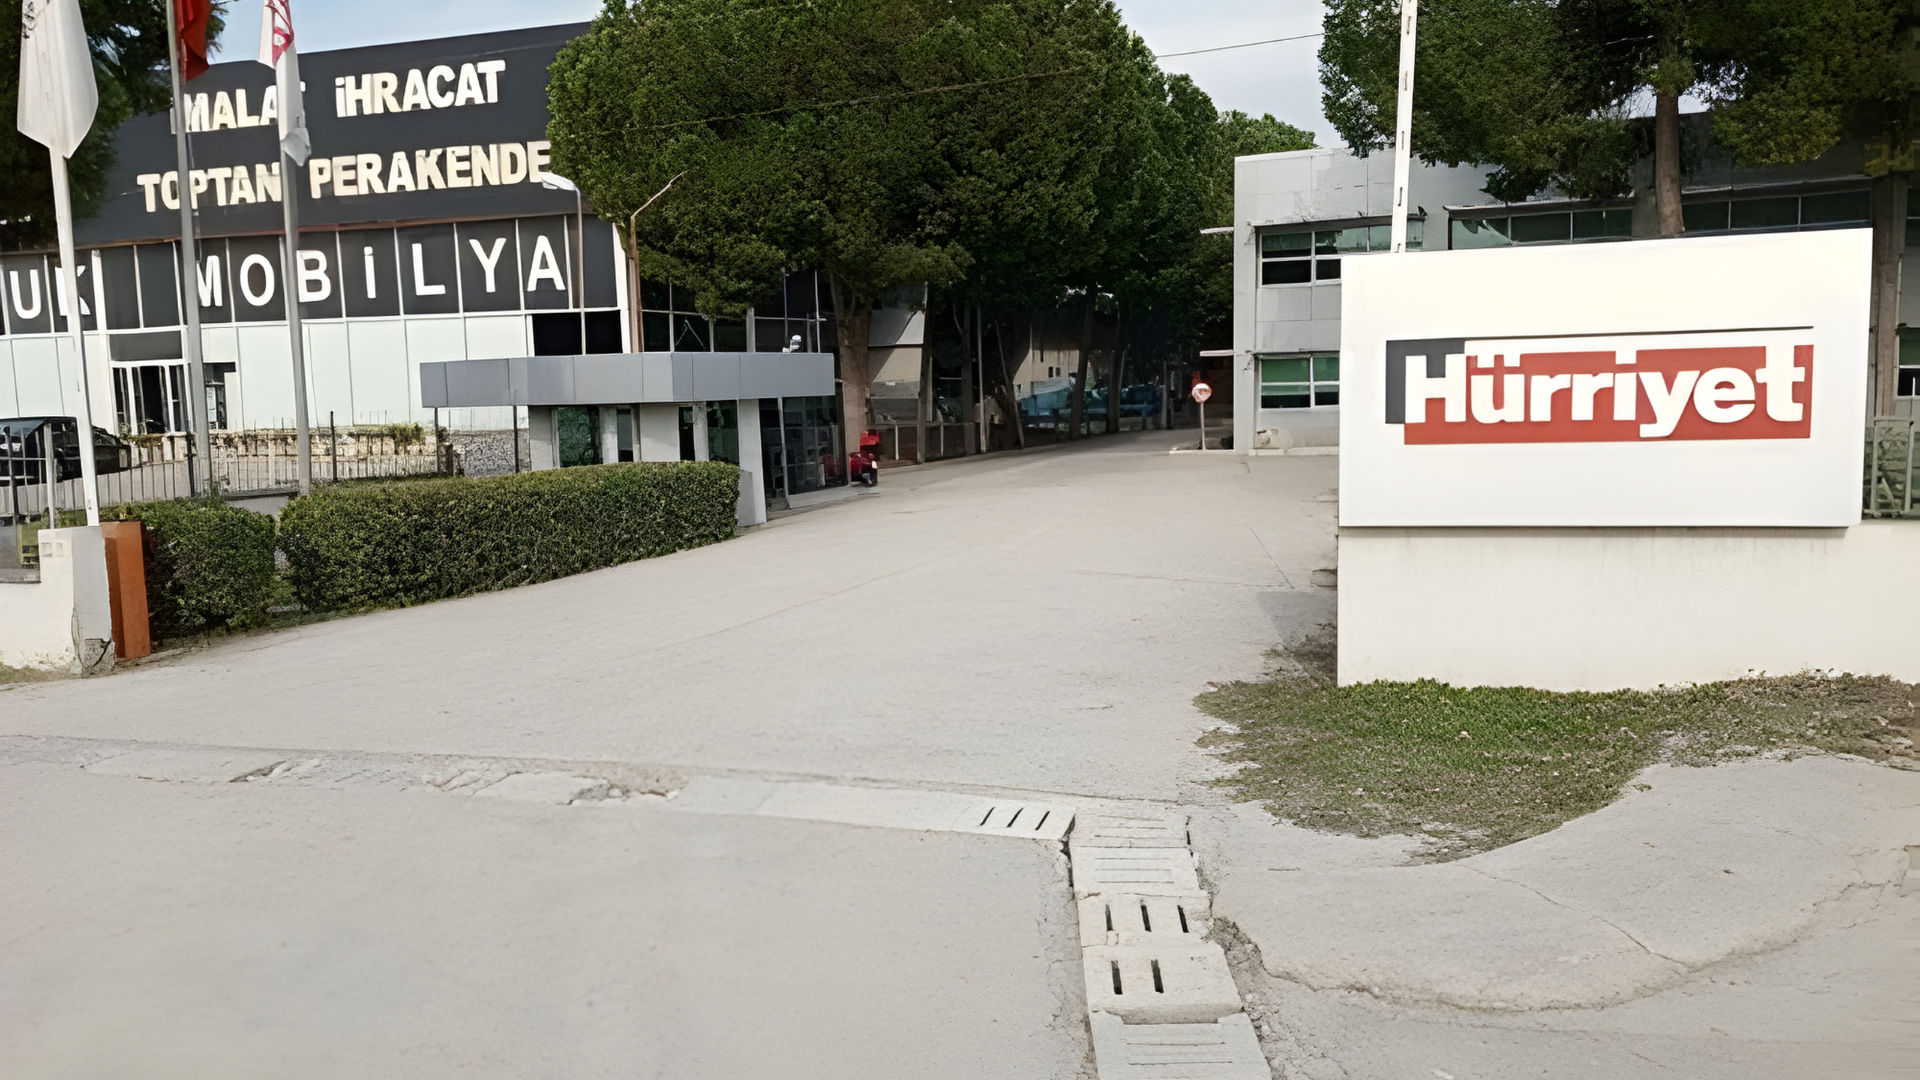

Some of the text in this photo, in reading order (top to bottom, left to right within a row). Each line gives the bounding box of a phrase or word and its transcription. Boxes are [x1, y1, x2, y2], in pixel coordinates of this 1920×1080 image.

[136, 140, 551, 213] TOPTAN PERAKENDE
[1405, 342, 1806, 438] Hürriyet
